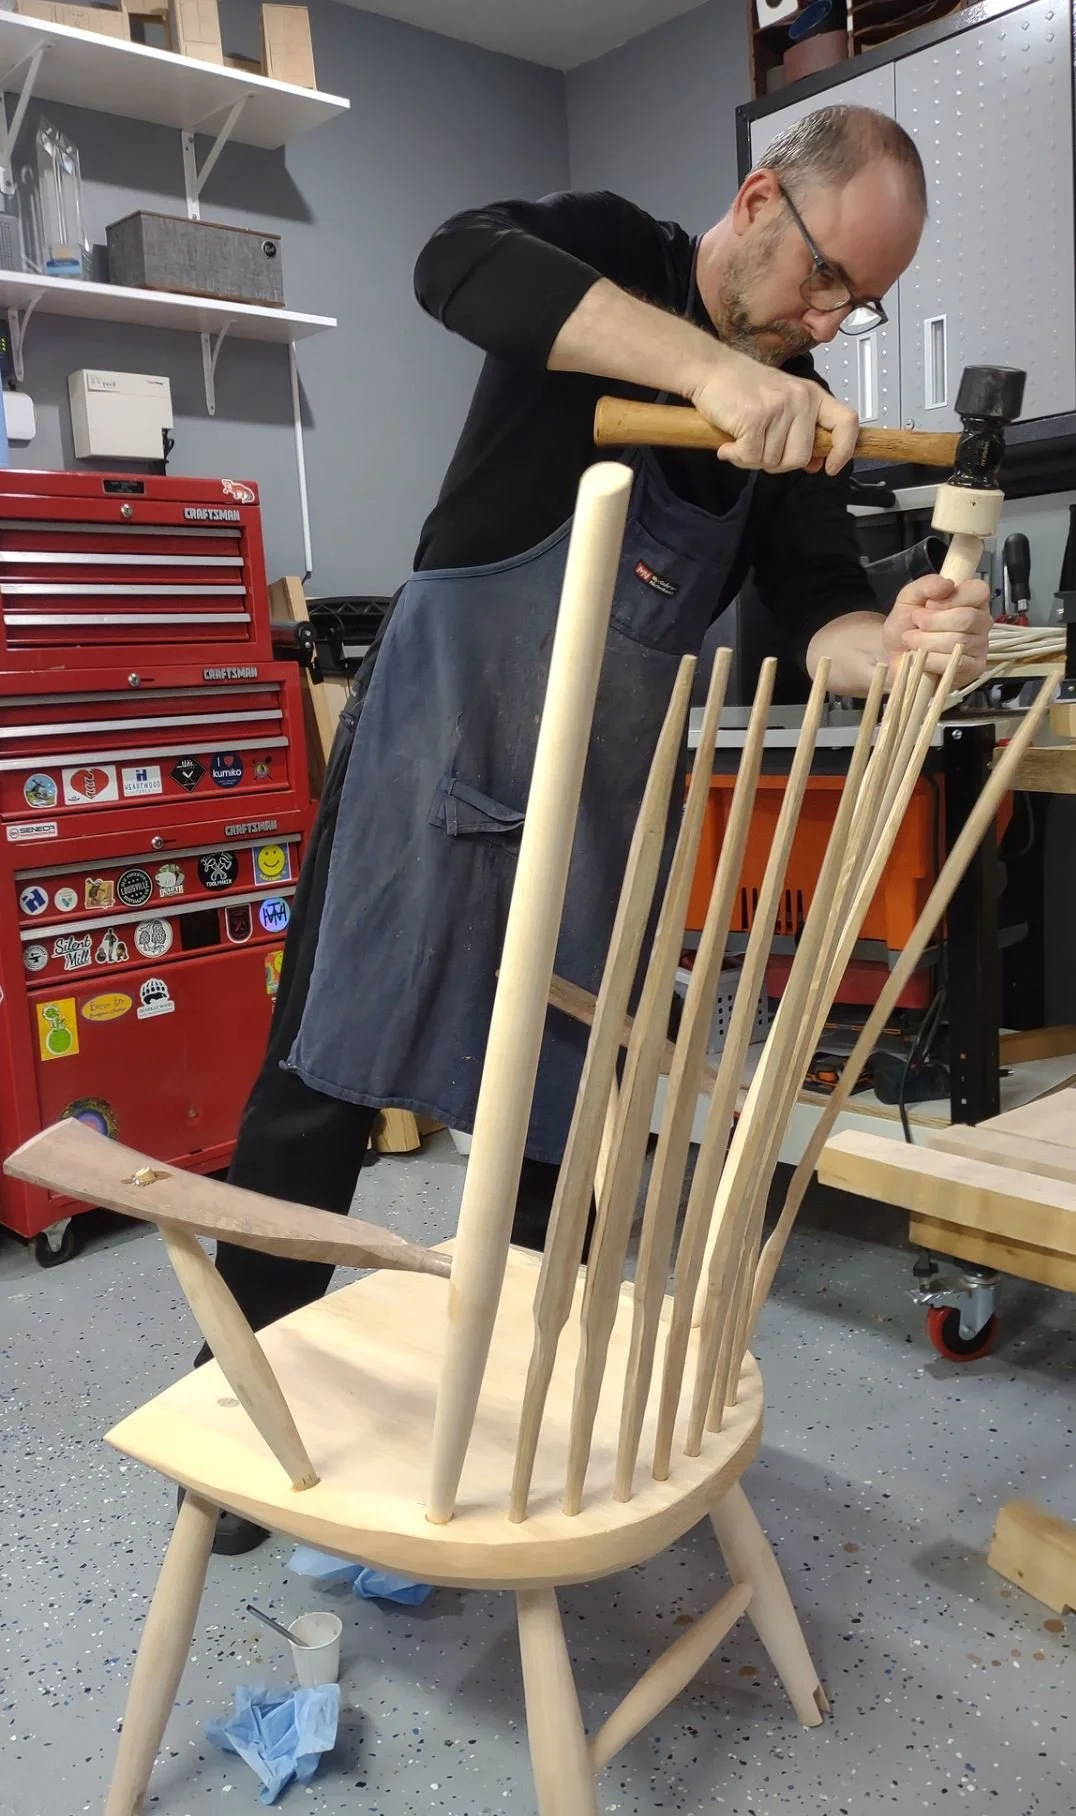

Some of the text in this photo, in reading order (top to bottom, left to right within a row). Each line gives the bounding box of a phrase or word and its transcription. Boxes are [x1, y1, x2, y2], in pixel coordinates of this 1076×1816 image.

[184, 508, 240, 521] CRAFTSMAN
[204, 667, 258, 680] CRAFTSMAN
[213, 768, 242, 778] kumiko
[20, 825, 55, 833] SENECA
[225, 820, 278, 836] CRAFTSMAN
[120, 880, 150, 896] LOUISVILLE
[205, 879, 232, 887] TOOLMAKER
[55, 934, 91, 954] Silent
[66, 948, 89, 968] Mill
